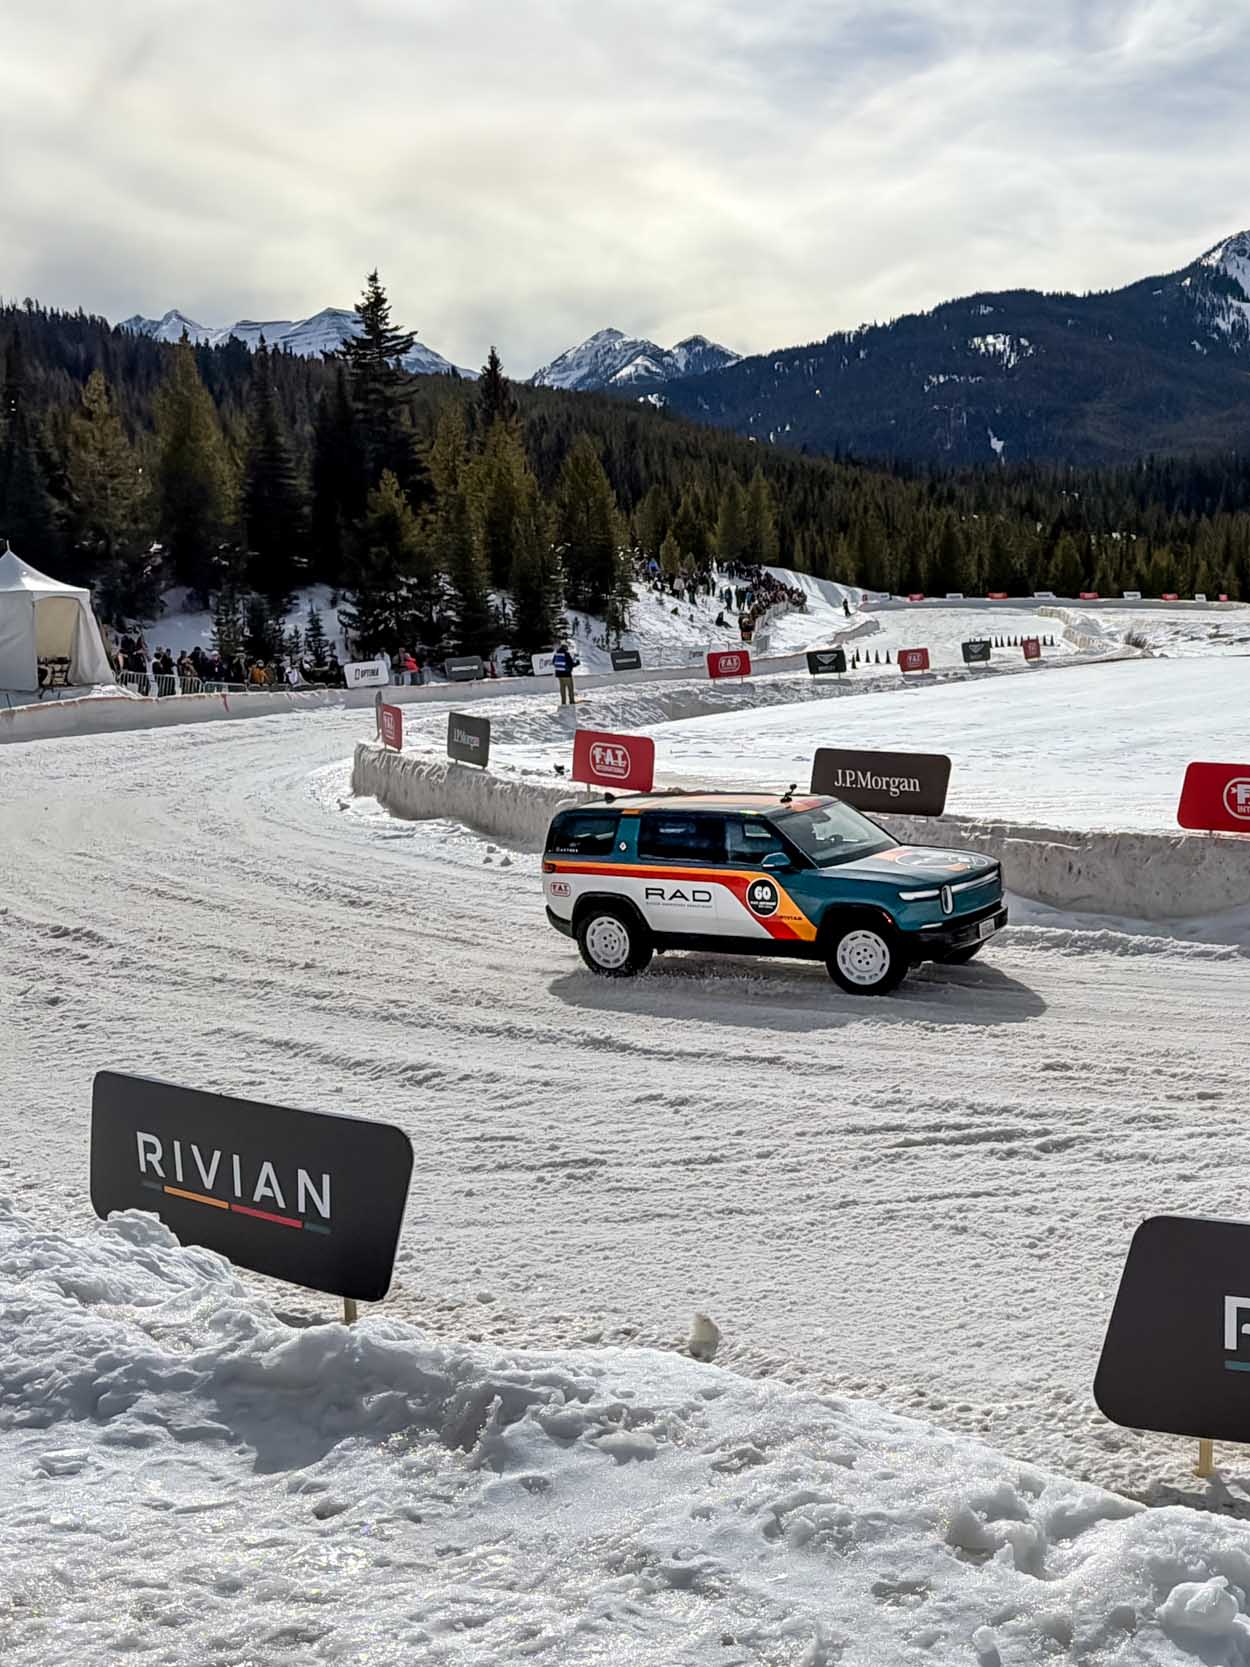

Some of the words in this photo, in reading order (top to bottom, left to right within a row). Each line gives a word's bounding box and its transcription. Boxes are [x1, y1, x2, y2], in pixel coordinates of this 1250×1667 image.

[834, 769, 920, 797] J.P.Morgan
[644, 887, 712, 903] RAD
[754, 886, 771, 900] 60
[136, 1130, 331, 1219] RIVIAN
